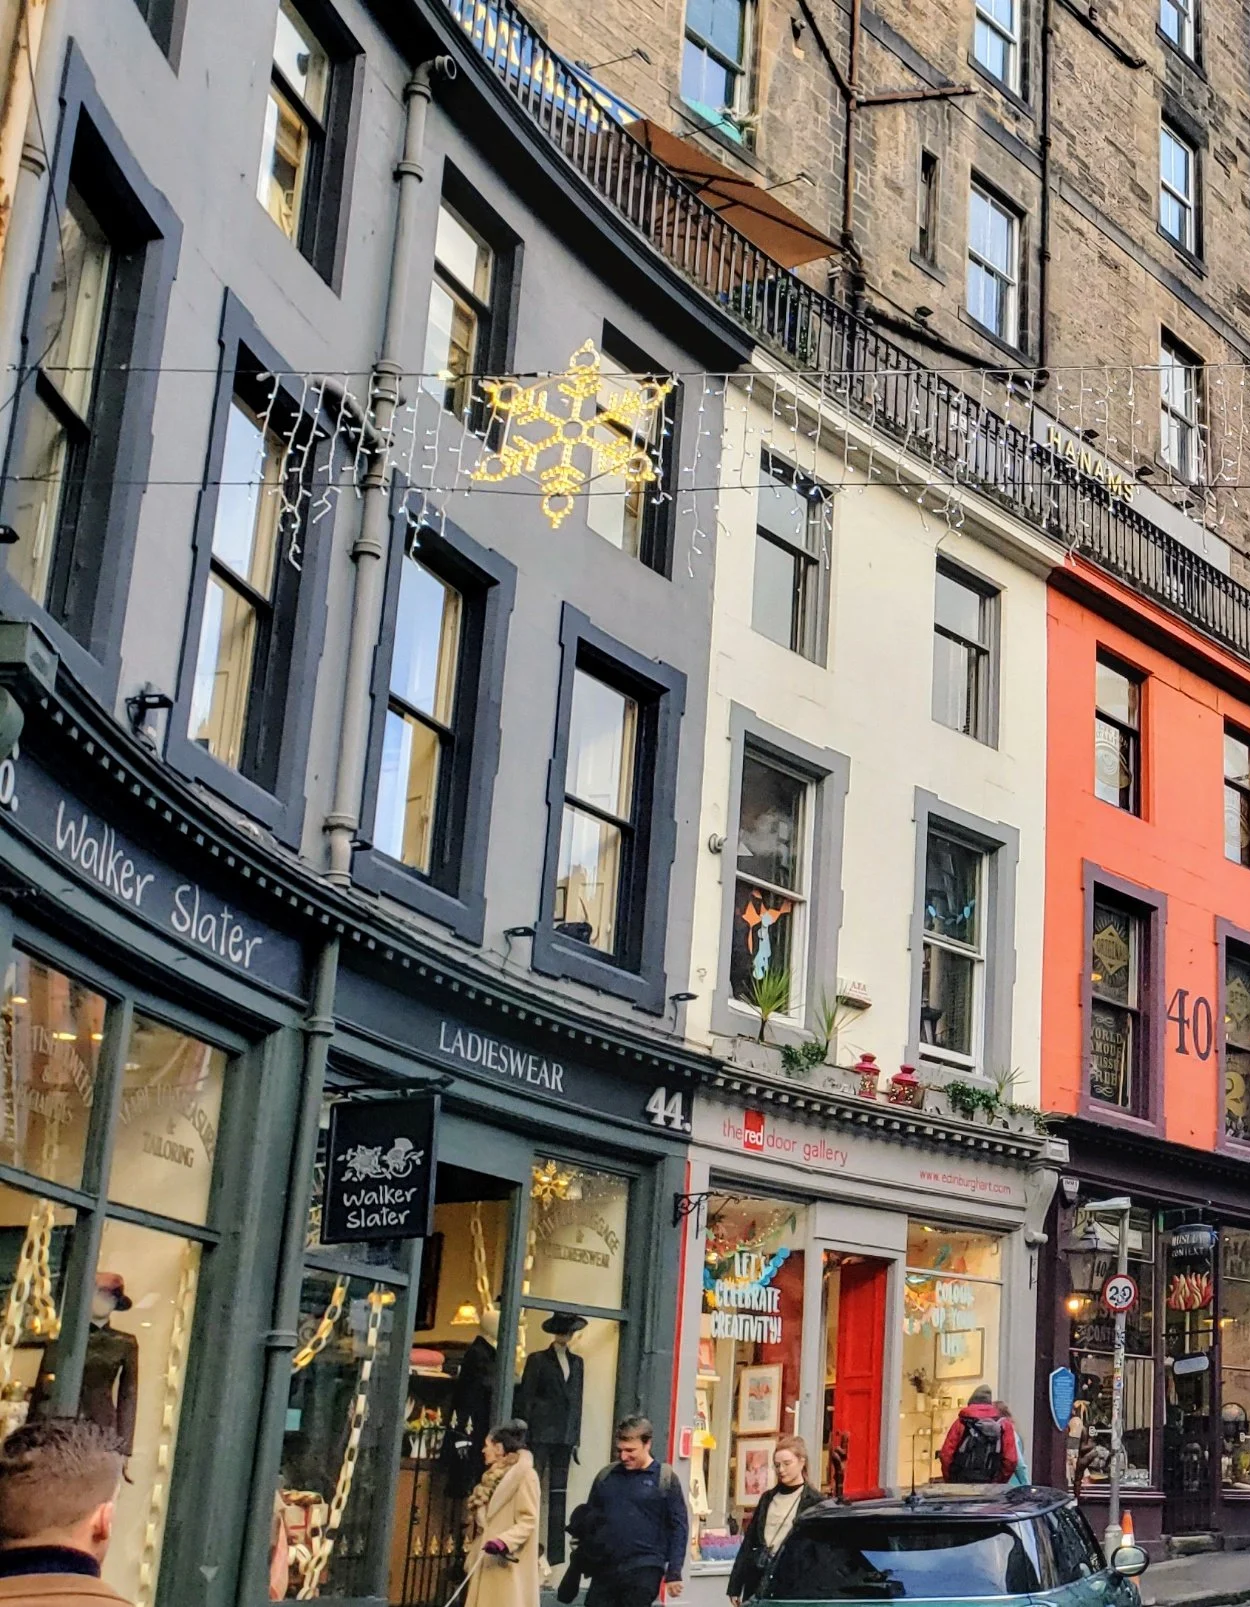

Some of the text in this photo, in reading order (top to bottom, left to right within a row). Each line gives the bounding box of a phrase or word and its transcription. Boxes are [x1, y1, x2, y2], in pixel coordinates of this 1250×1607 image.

[56, 800, 262, 968] Walker Slater
[1167, 988, 1213, 1061] 40
[438, 1021, 564, 1093] LADIESWEAR
[143, 1130, 195, 1169] TAILORING
[722, 1118, 849, 1168] the red door gallery
[715, 1279, 782, 1313] CELEBRATE
[710, 1309, 782, 1345] CREATIVITY!
